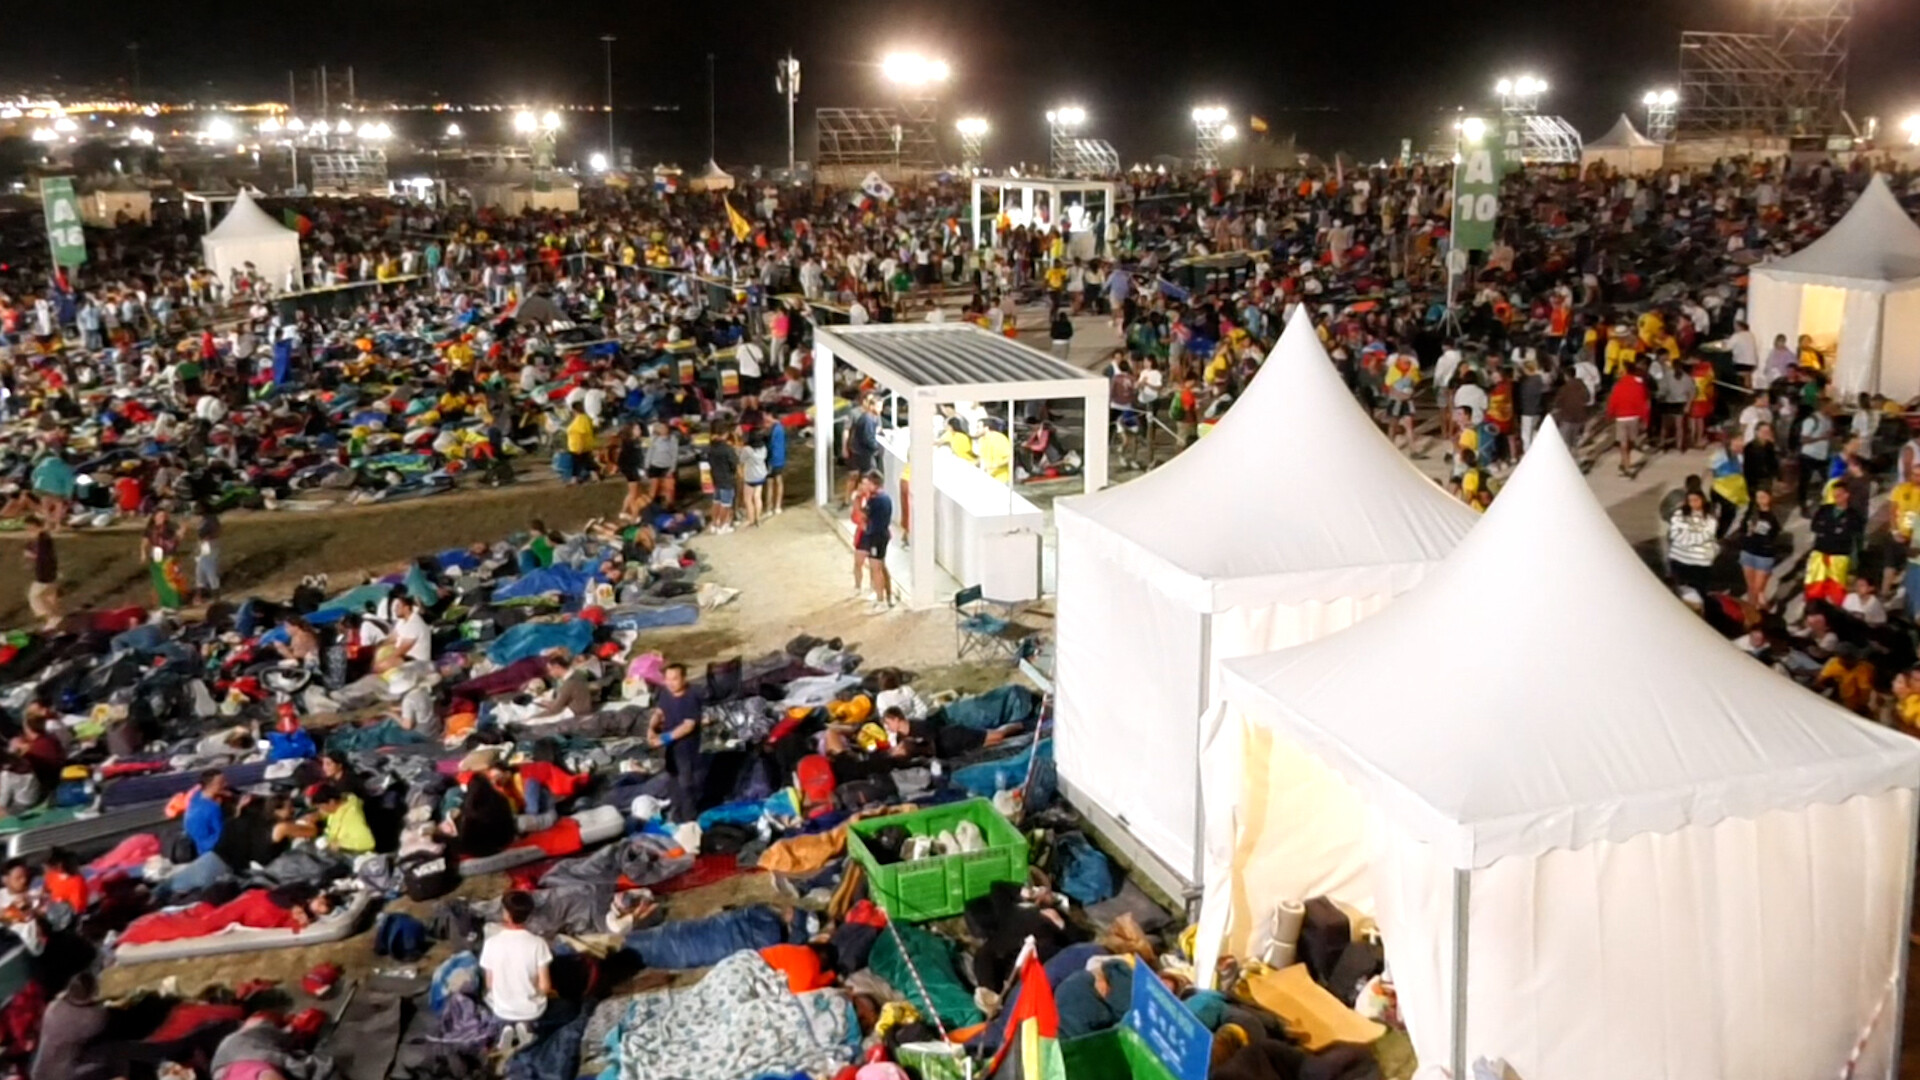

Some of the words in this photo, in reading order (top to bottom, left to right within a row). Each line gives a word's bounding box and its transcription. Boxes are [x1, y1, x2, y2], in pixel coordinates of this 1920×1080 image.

[1464, 150, 1493, 184] A
[53, 198, 76, 222] A
[1458, 194, 1497, 221] 10
[51, 226, 84, 247] 16
